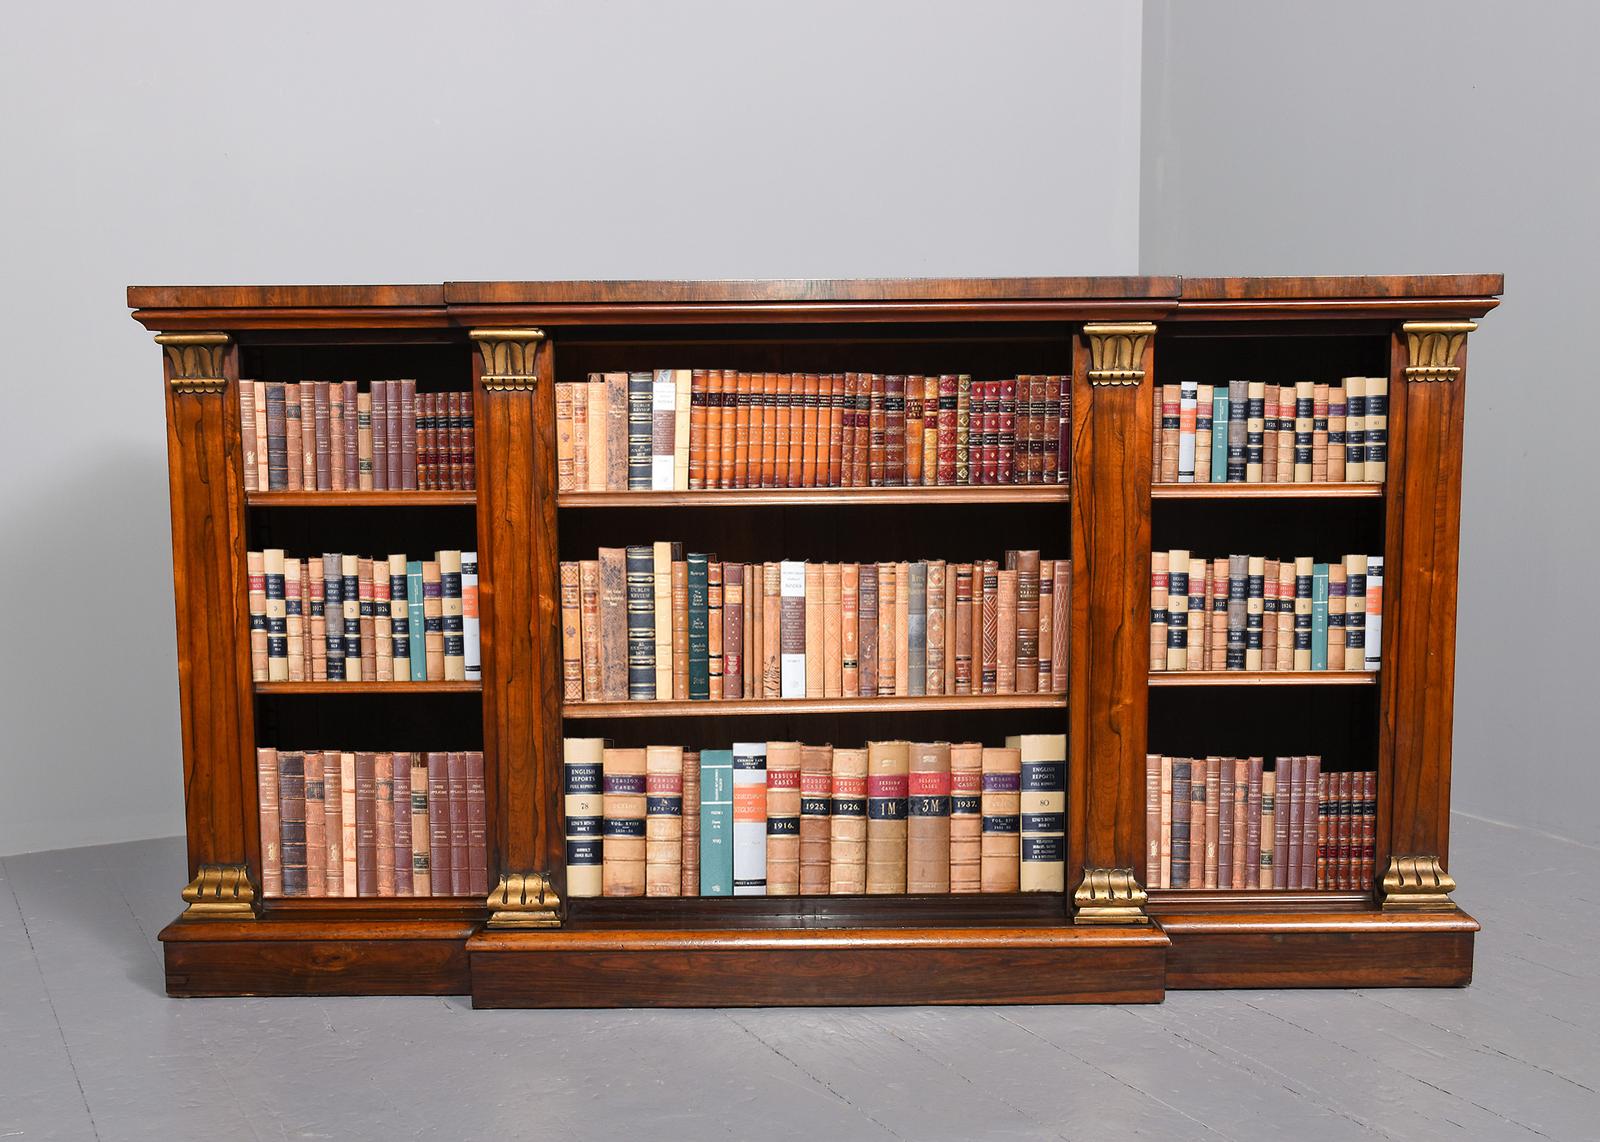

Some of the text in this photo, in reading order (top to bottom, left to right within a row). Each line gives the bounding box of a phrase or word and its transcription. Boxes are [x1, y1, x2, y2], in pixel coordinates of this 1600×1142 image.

[881, 802, 896, 815] 1 M
[922, 800, 939, 812] 3 M
